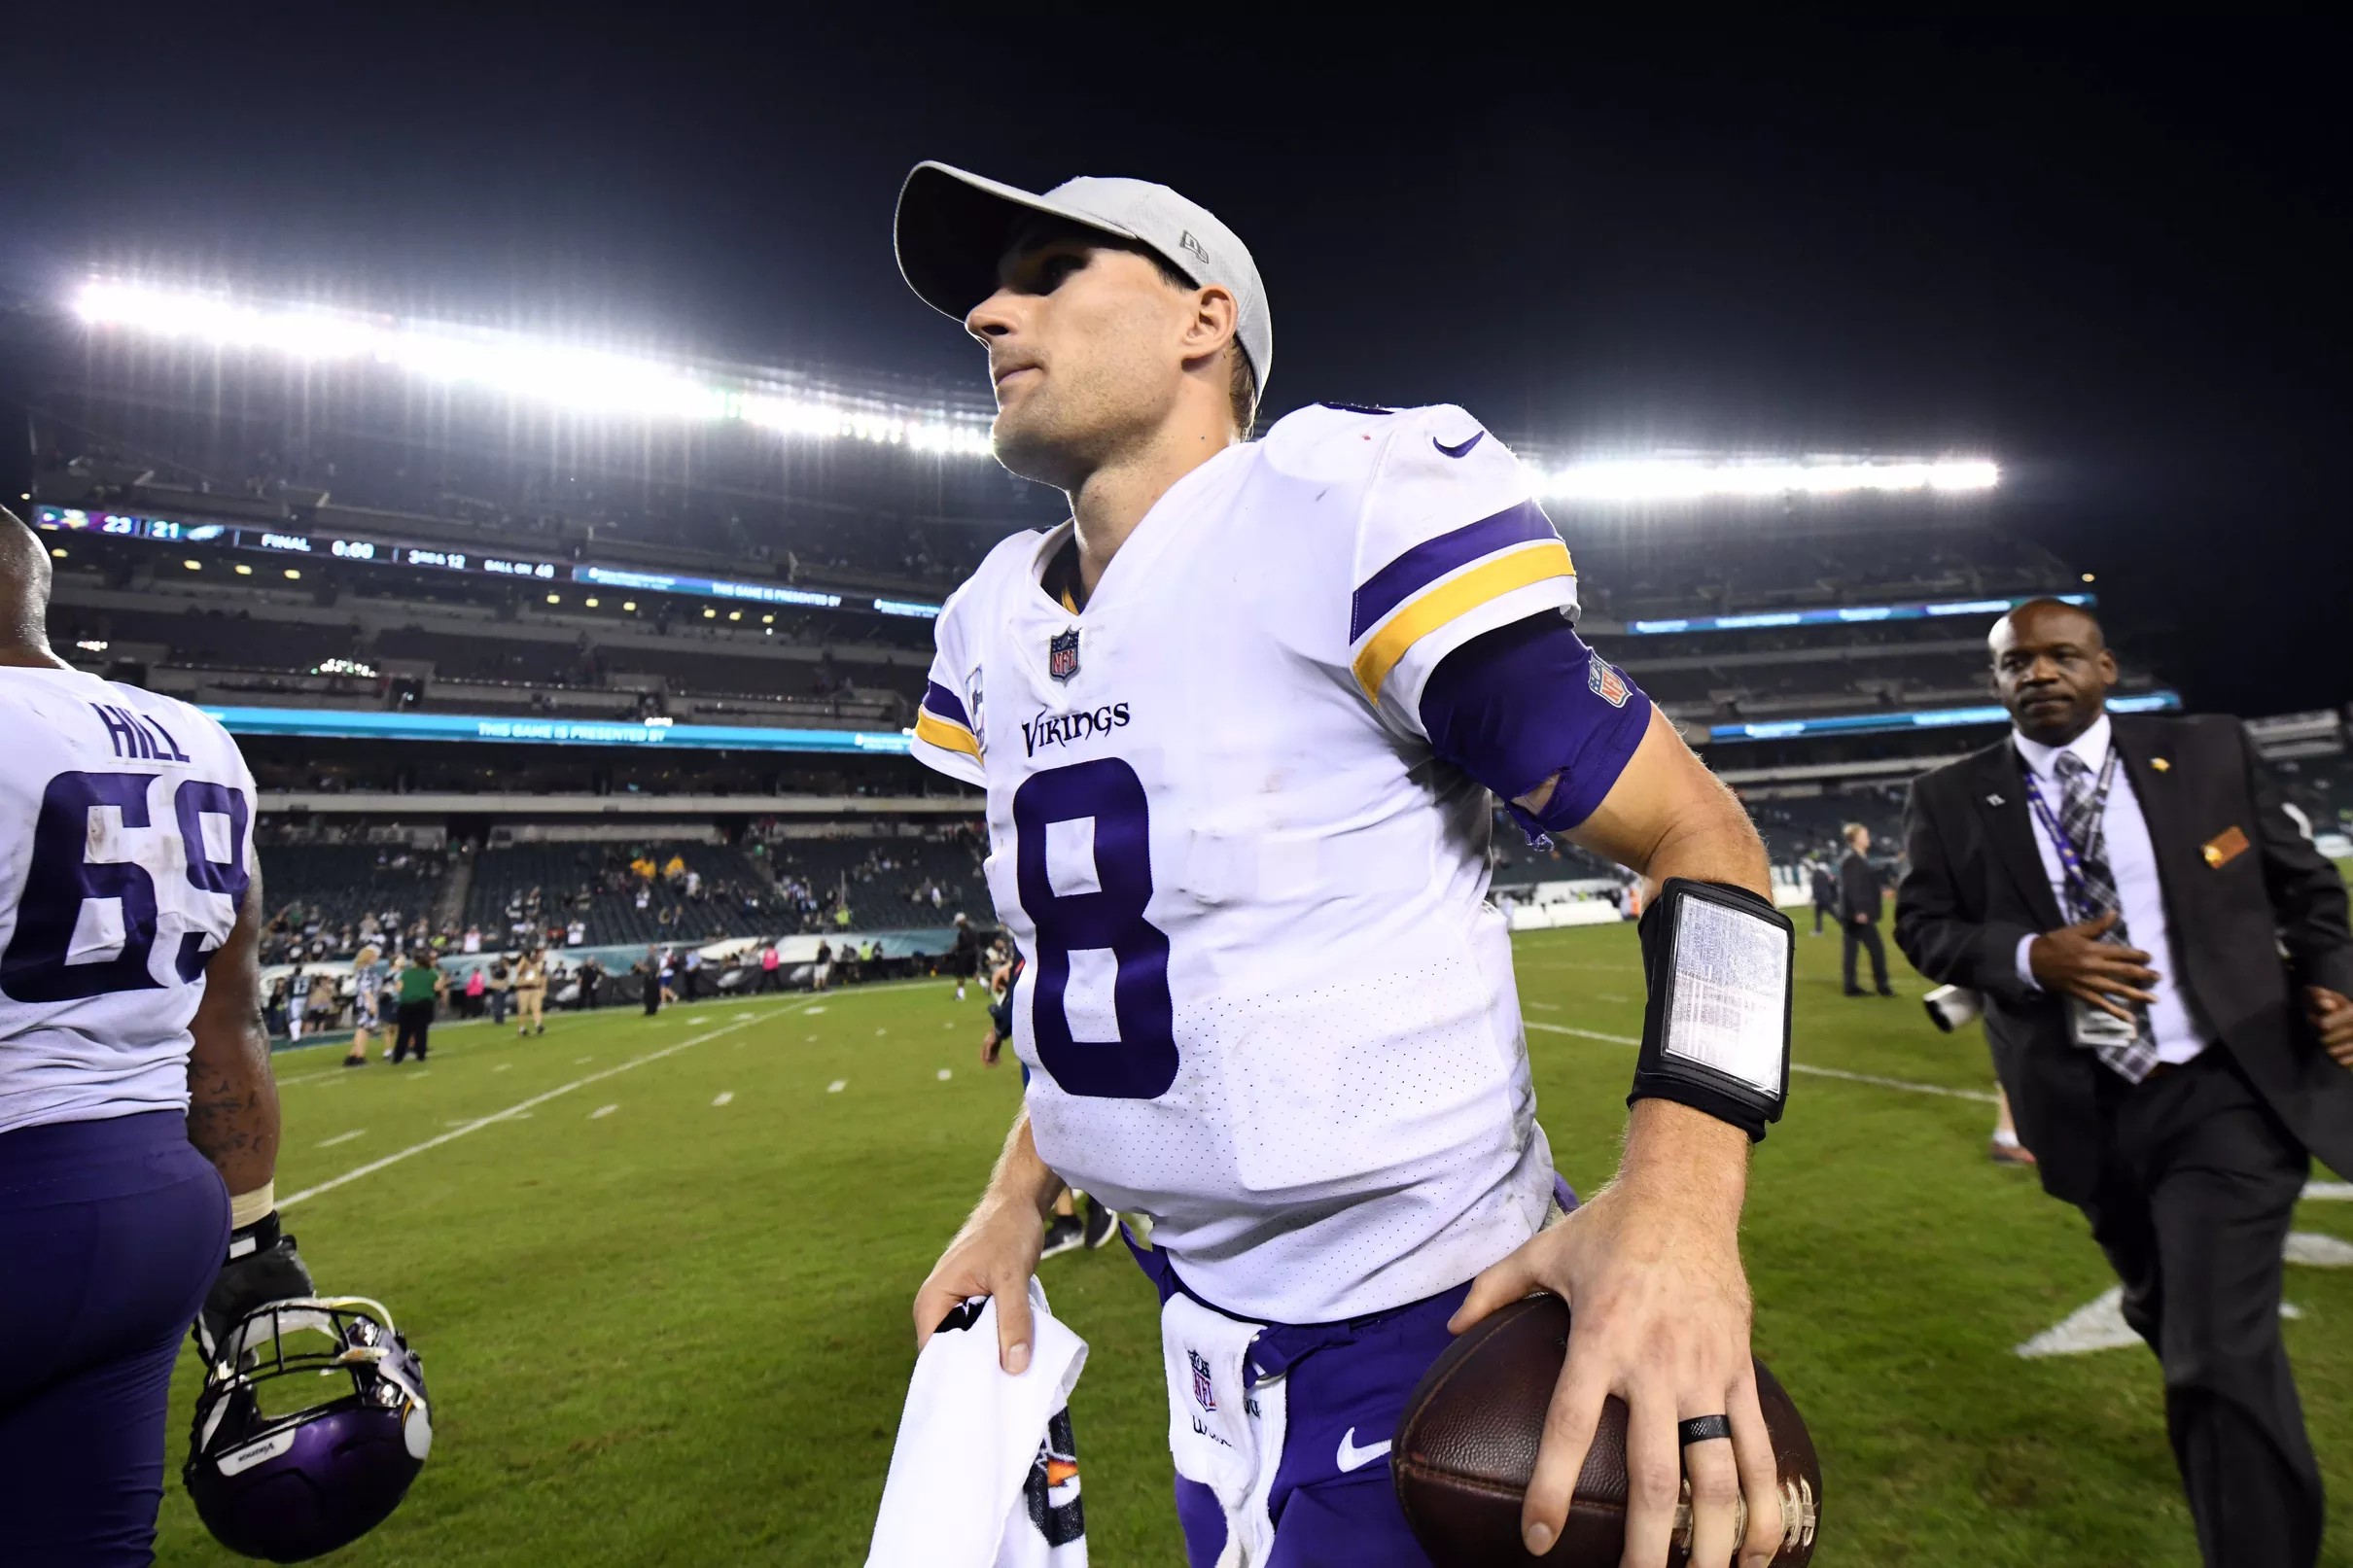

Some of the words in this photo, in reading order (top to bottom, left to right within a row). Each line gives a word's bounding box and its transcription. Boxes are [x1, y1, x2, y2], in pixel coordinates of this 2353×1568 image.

[102, 515, 132, 534] 23
[152, 521, 180, 539] 21
[261, 533, 311, 552] FINAL
[331, 540, 374, 560] 0:00
[712, 582, 734, 596] THIS
[735, 585, 763, 599] GAME
[763, 588, 774, 600] IS
[774, 589, 828, 606] PRESENTED
[828, 596, 841, 608] BY
[1053, 649, 1076, 675] NFL
[89, 702, 191, 763] HILL
[478, 721, 511, 737] THIS
[511, 723, 553, 740] GAME
[553, 724, 569, 740] IS
[569, 725, 649, 743] PRESENTED
[648, 728, 666, 743] BY
[0, 770, 251, 1003] 69
[1012, 757, 1180, 1099] 8
[1192, 1369, 1216, 1407] NFL
